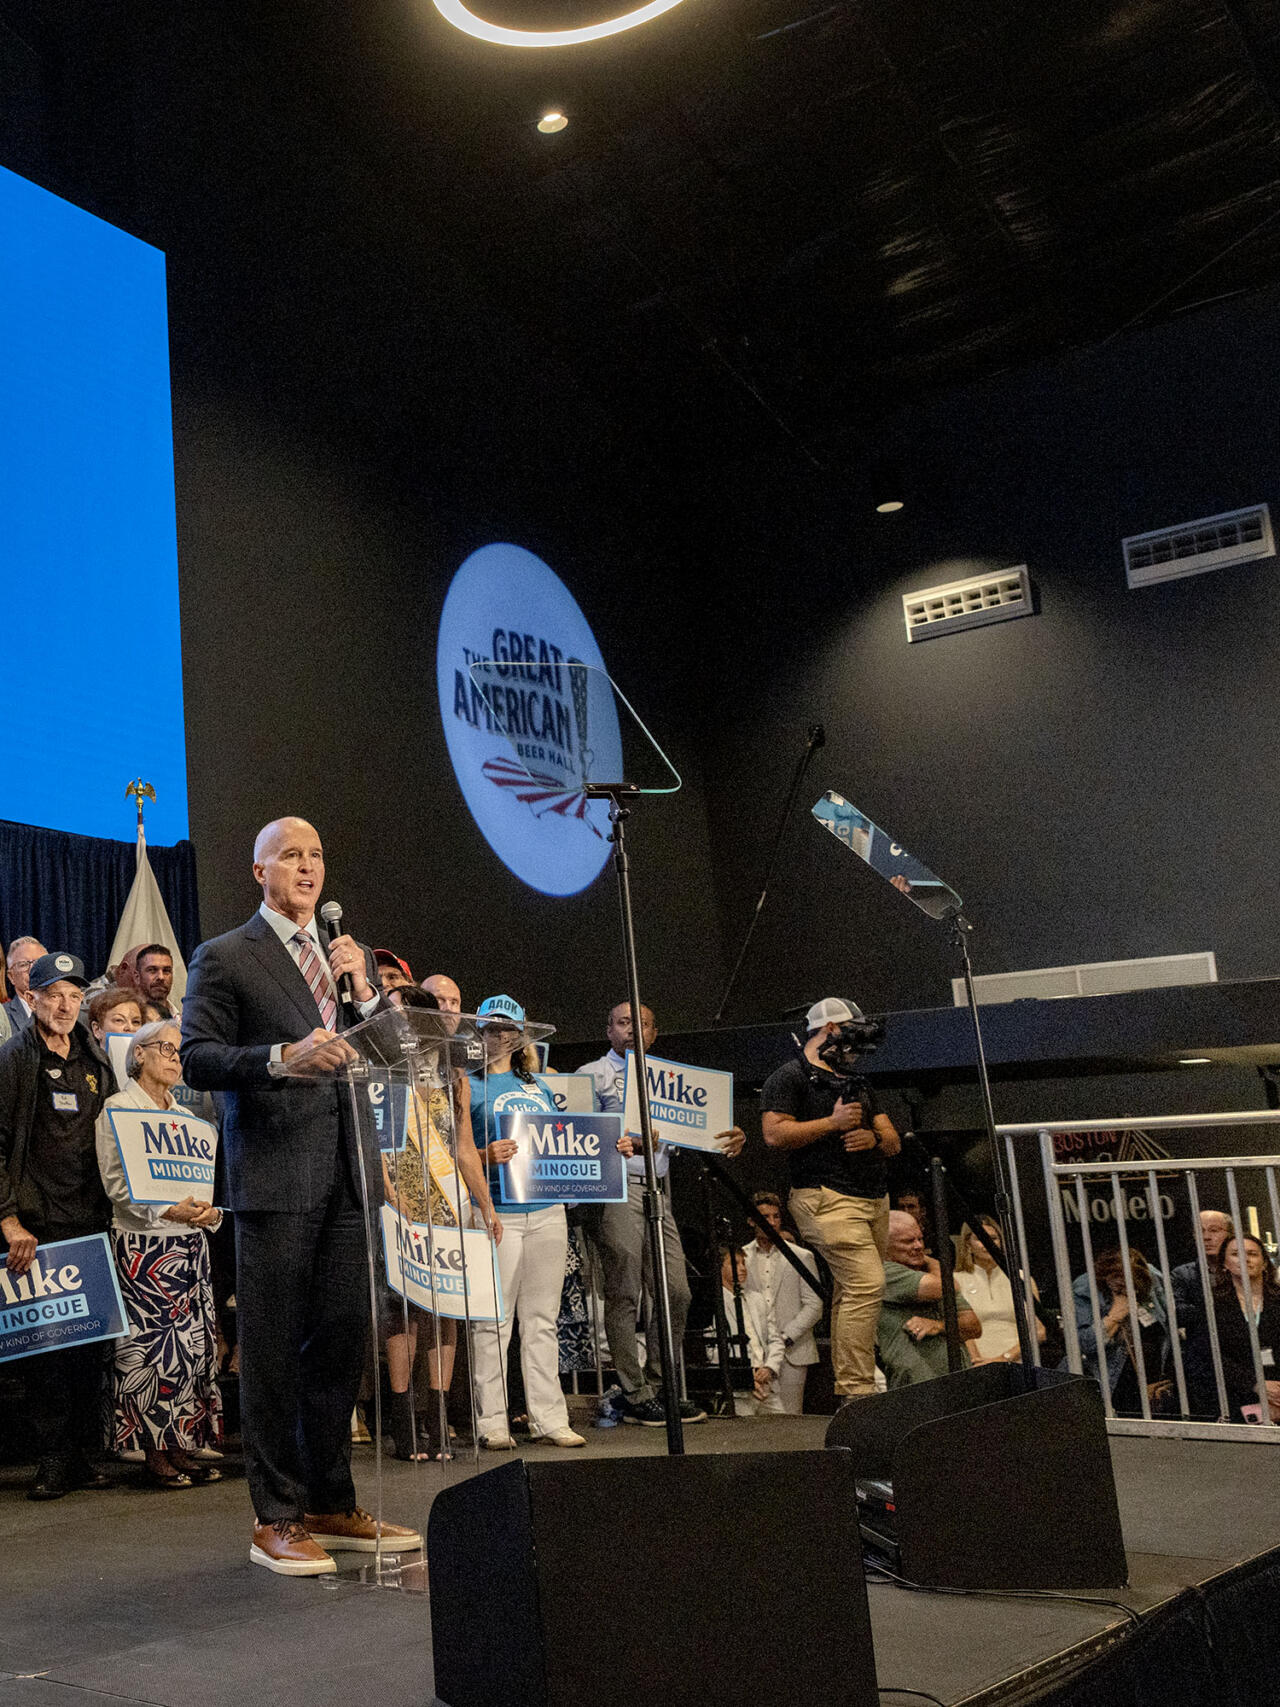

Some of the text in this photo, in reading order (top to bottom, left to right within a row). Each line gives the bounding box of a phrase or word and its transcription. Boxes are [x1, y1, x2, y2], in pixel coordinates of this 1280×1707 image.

[462, 628, 563, 695] THE GREAT
[454, 667, 573, 755] AMERICAN
[517, 743, 575, 775] BEER HALL
[647, 1066, 707, 1107] Mike
[141, 1121, 214, 1162] Mike
[528, 1121, 600, 1156] Mike
[532, 1163, 597, 1177] MINOGUE
[395, 1220, 467, 1271] Mike
[5, 1335, 30, 1348] KIND
[32, 1331, 45, 1341] OF
[47, 1320, 101, 1338] GOVERNOR
